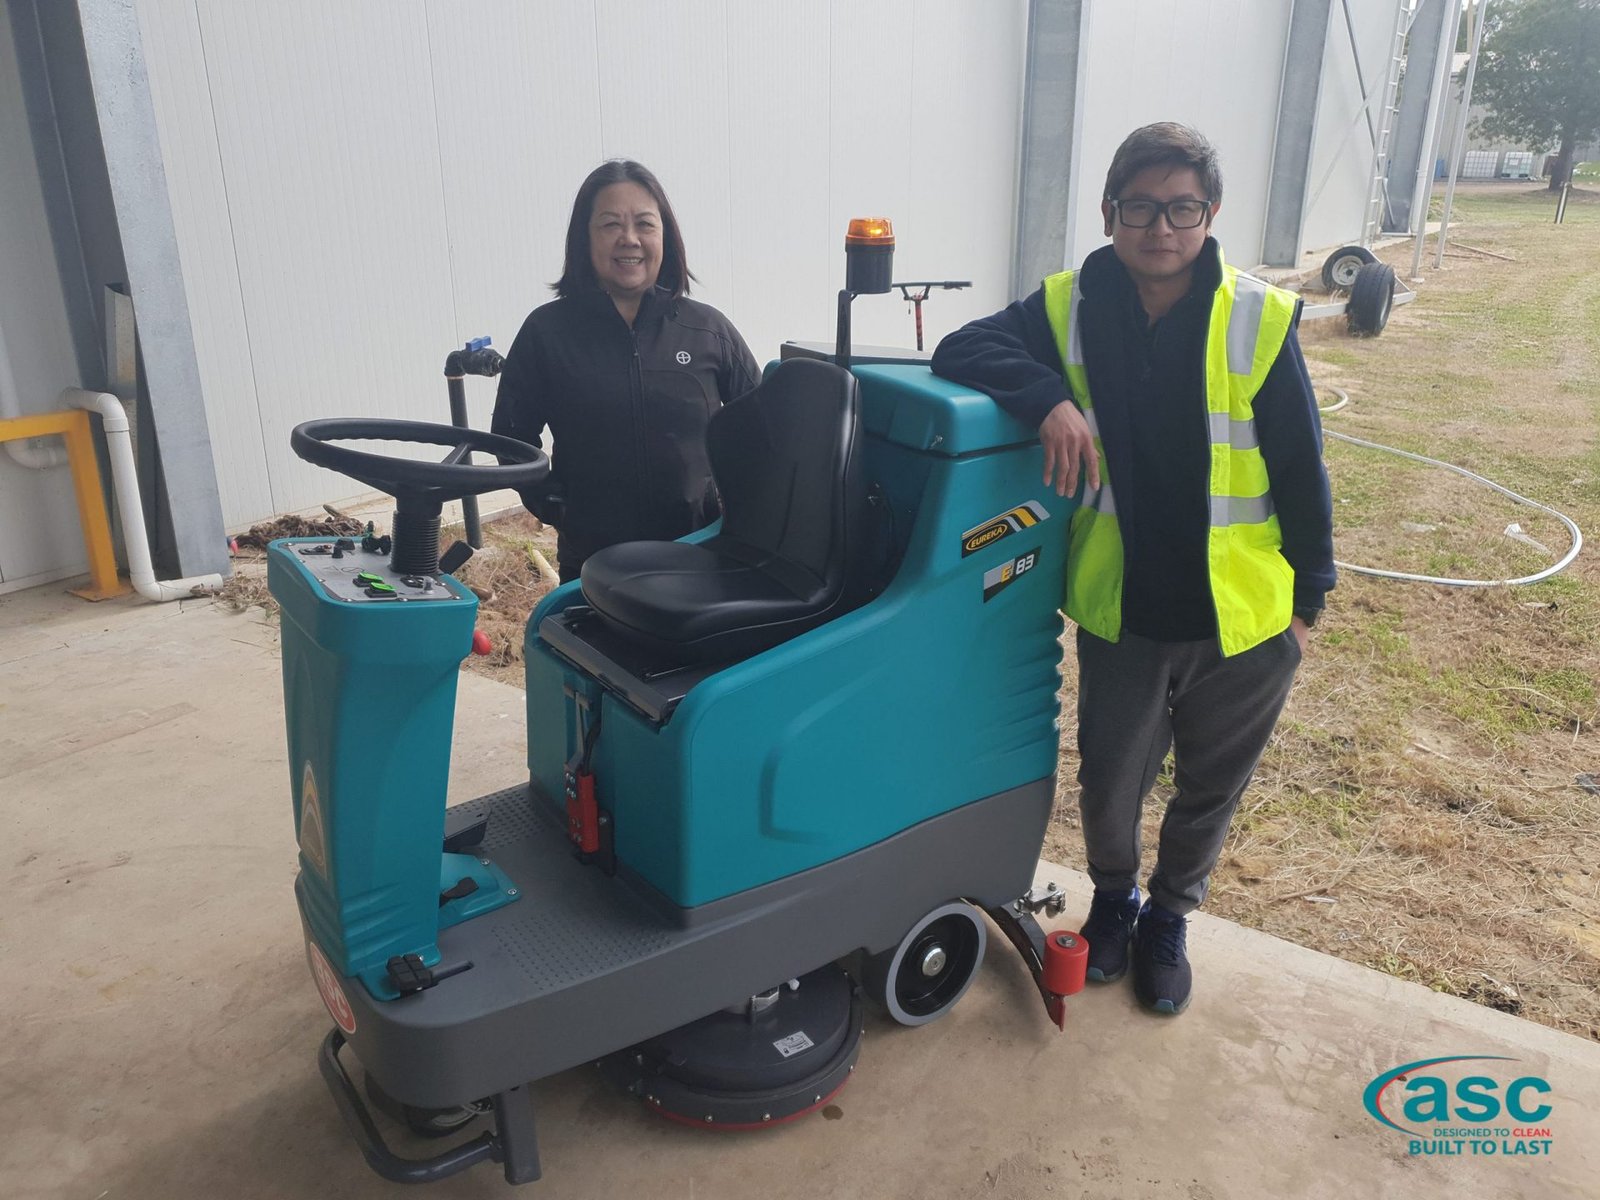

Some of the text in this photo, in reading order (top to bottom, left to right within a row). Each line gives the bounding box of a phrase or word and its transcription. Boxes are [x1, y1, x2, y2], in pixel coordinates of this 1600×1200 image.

[970, 526, 1003, 548] EUREKA
[1000, 554, 1035, 583] E 83
